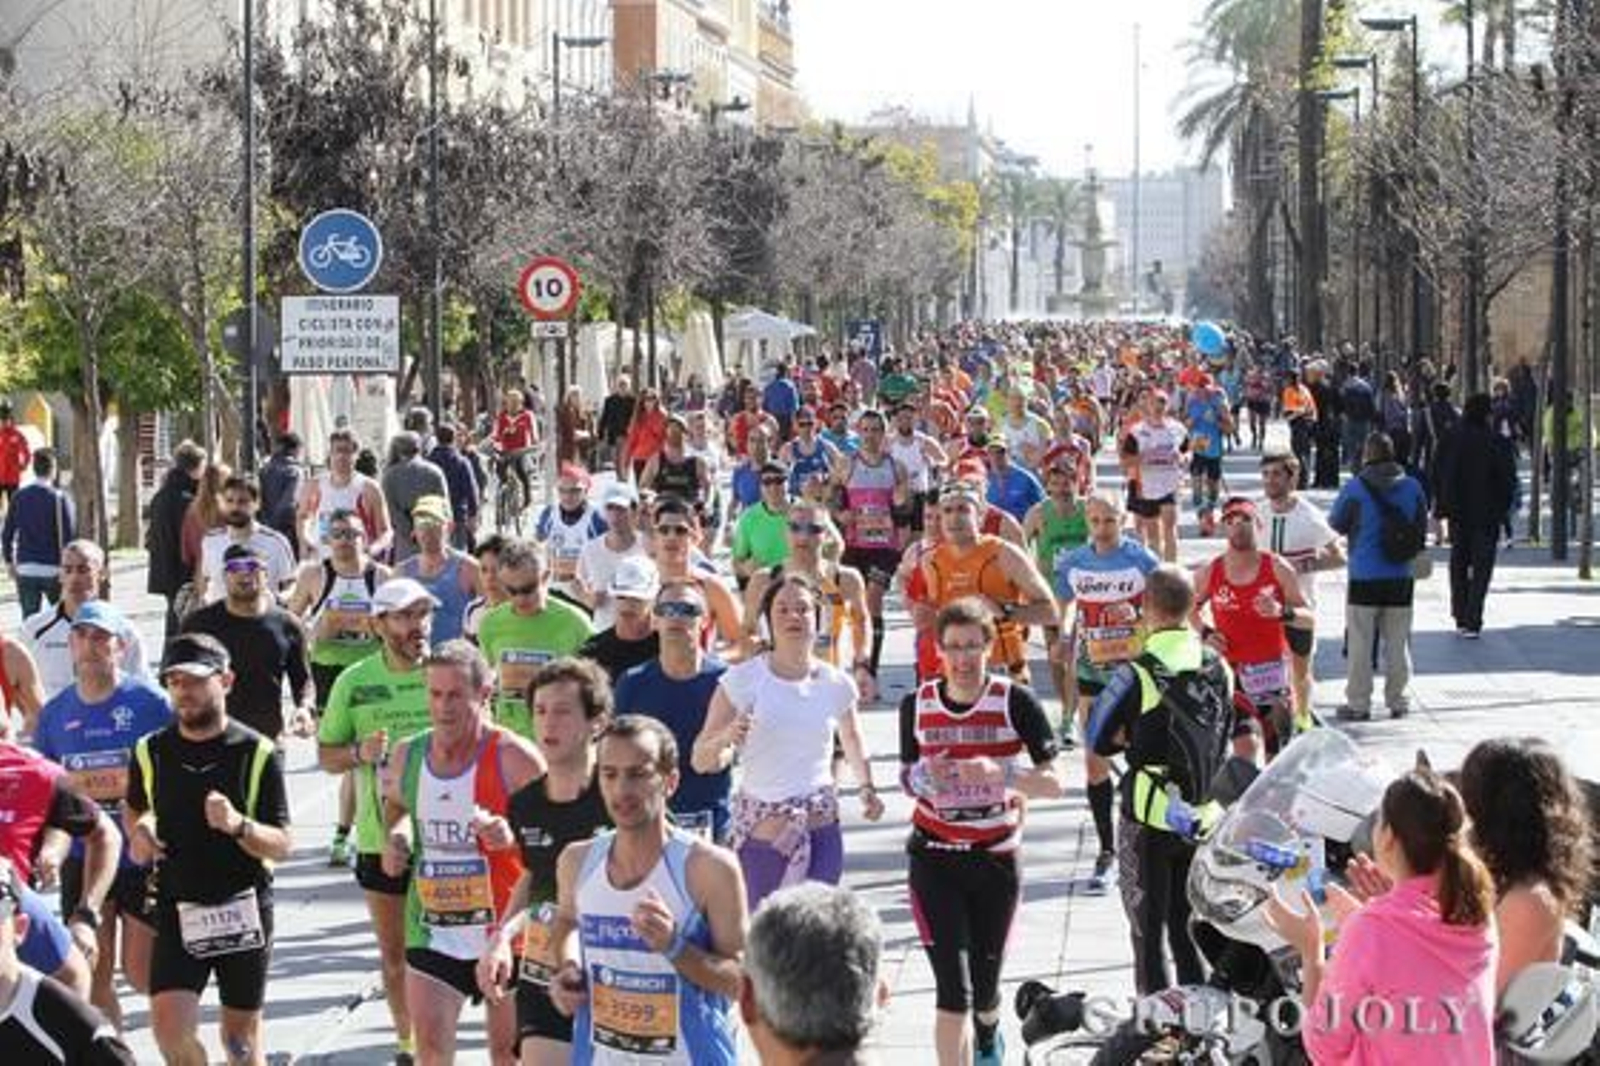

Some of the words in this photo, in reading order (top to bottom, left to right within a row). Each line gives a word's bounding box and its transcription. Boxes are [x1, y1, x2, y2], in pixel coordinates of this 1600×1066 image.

[535, 279, 562, 297] 10
[298, 318, 352, 331] CICLISTA
[298, 336, 363, 349] PRIORIDAD
[365, 336, 380, 349] DE
[293, 356, 323, 369] PASO
